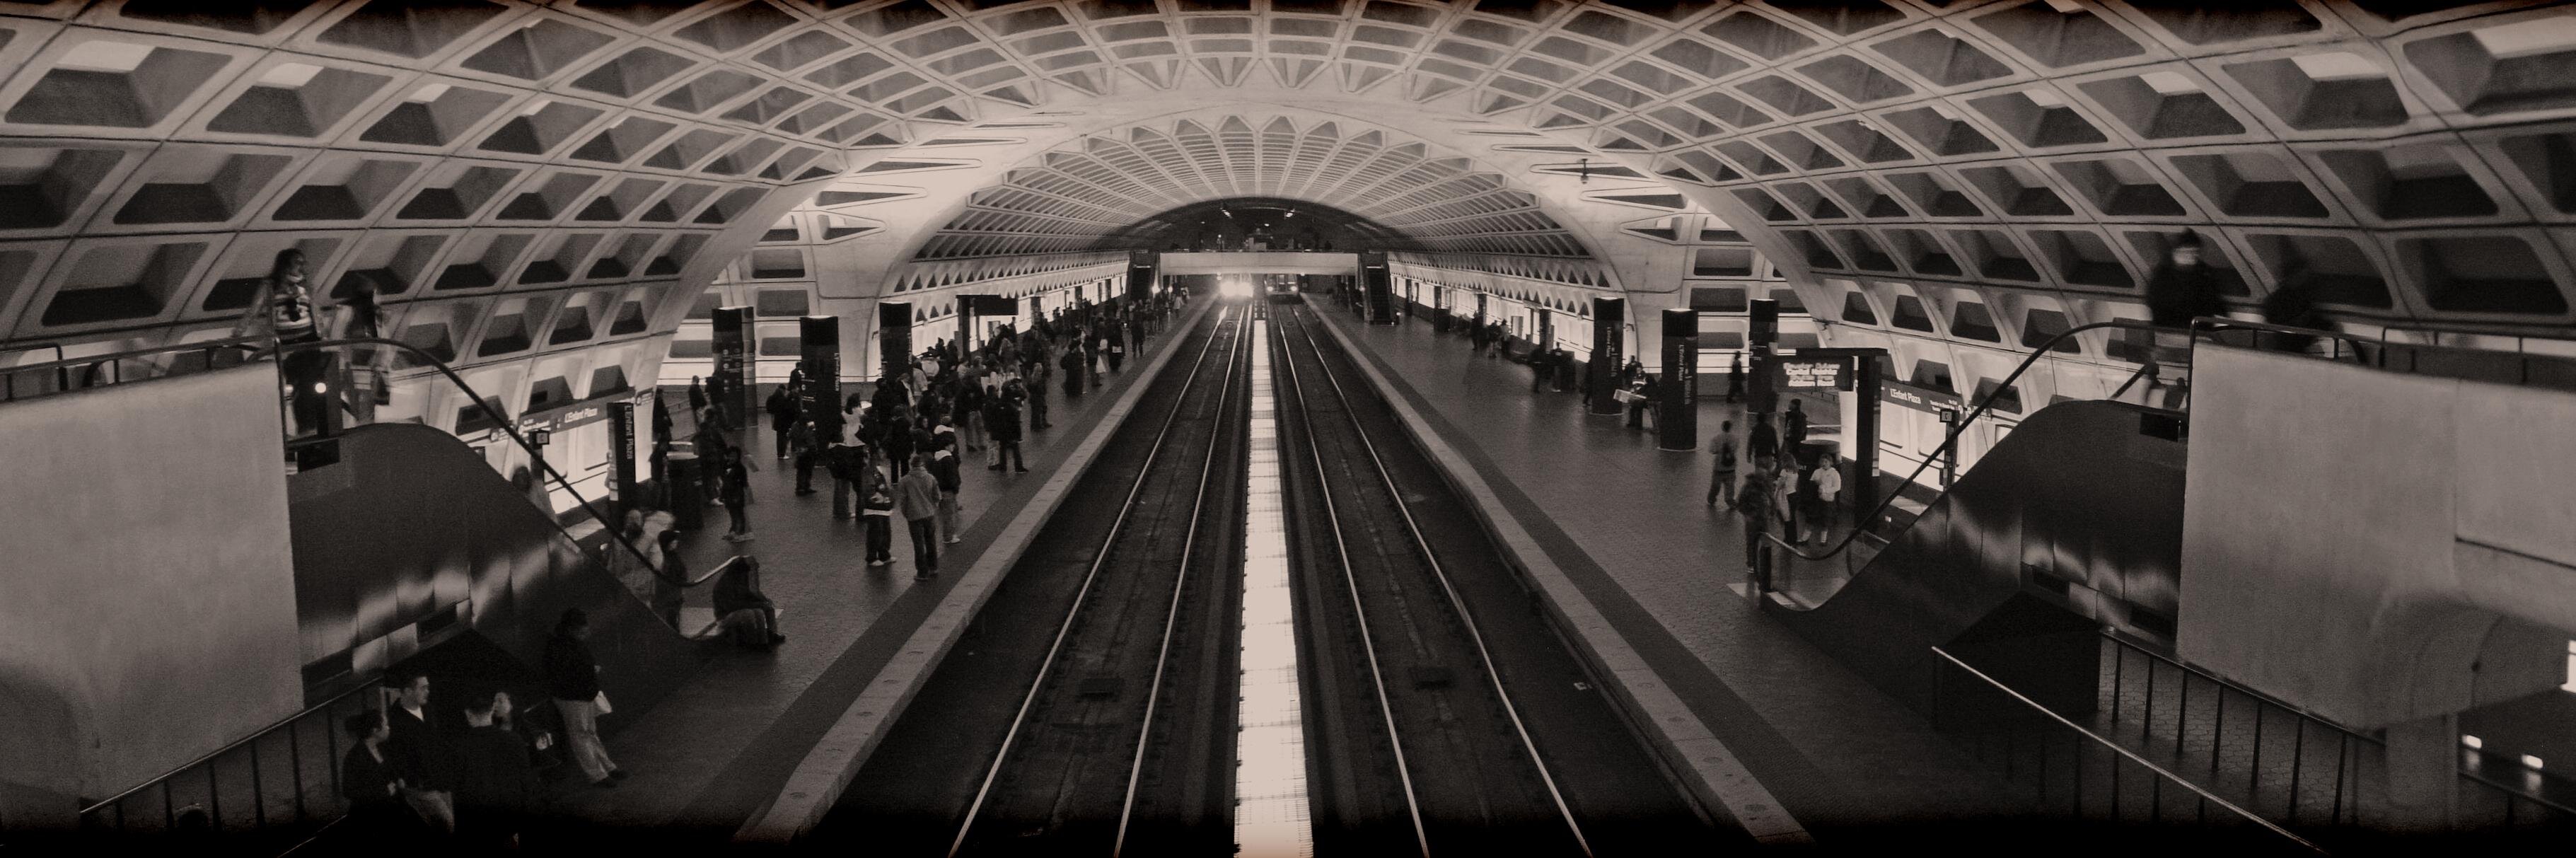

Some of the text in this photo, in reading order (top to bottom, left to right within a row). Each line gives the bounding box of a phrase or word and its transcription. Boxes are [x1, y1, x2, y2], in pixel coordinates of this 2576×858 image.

[1890, 388, 1921, 404] L'Enfant Plaza
[564, 408, 598, 423] L'Enfant Plaza
[624, 405, 634, 460] L'Enfant Plaza
